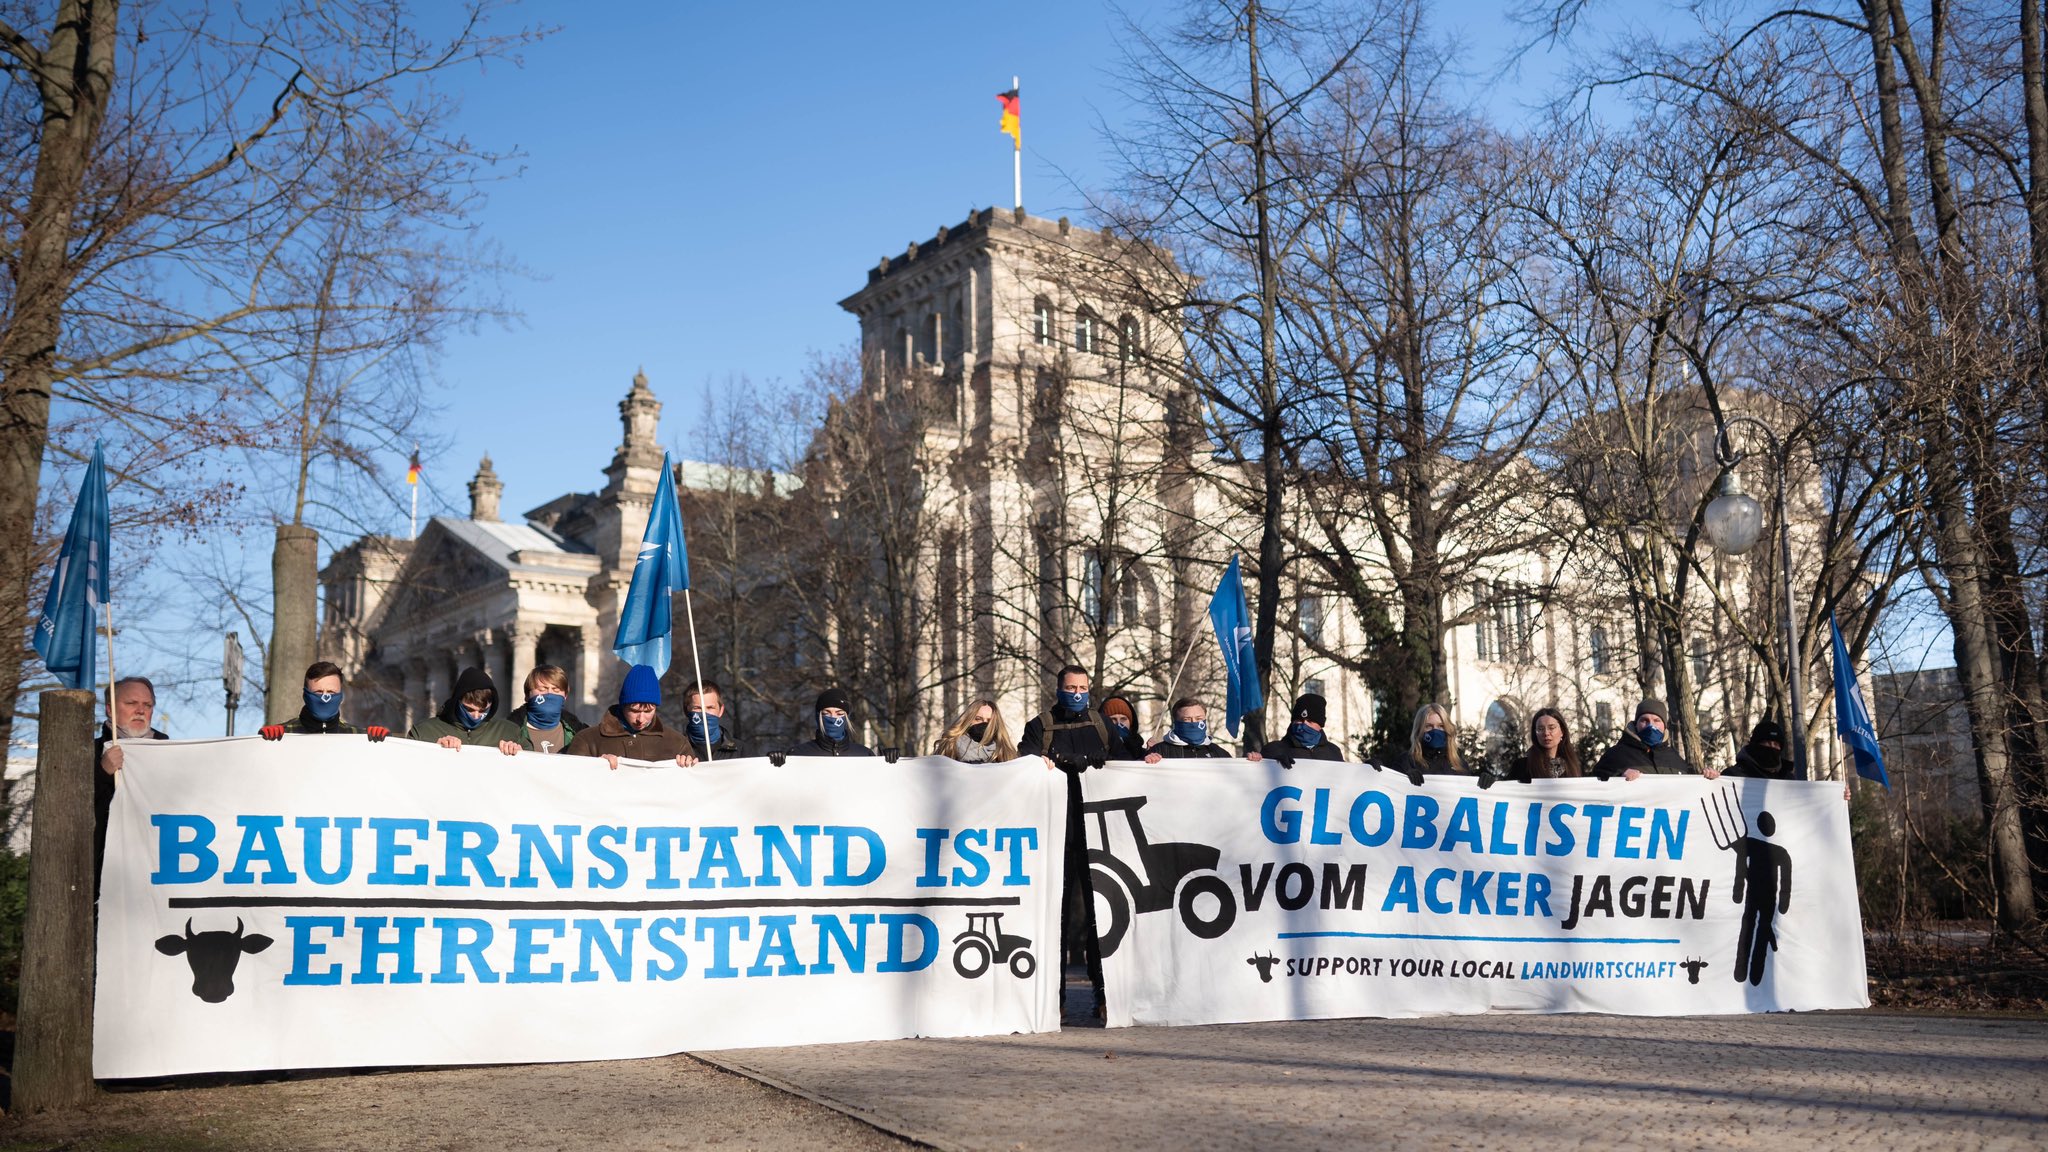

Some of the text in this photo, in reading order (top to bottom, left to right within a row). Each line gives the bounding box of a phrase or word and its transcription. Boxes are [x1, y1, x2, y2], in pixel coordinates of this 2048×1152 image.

[150, 814, 1039, 890] BAUERNSTAND IST
[1260, 785, 1691, 861] GLOBALISTEN
[1239, 862, 1711, 931] VOM ACKER JAGEN
[283, 913, 940, 987] EHRENSTAND
[1286, 956, 1677, 980] SUPPORT YOUR LOCAL LANDWIRTSCHAFT
